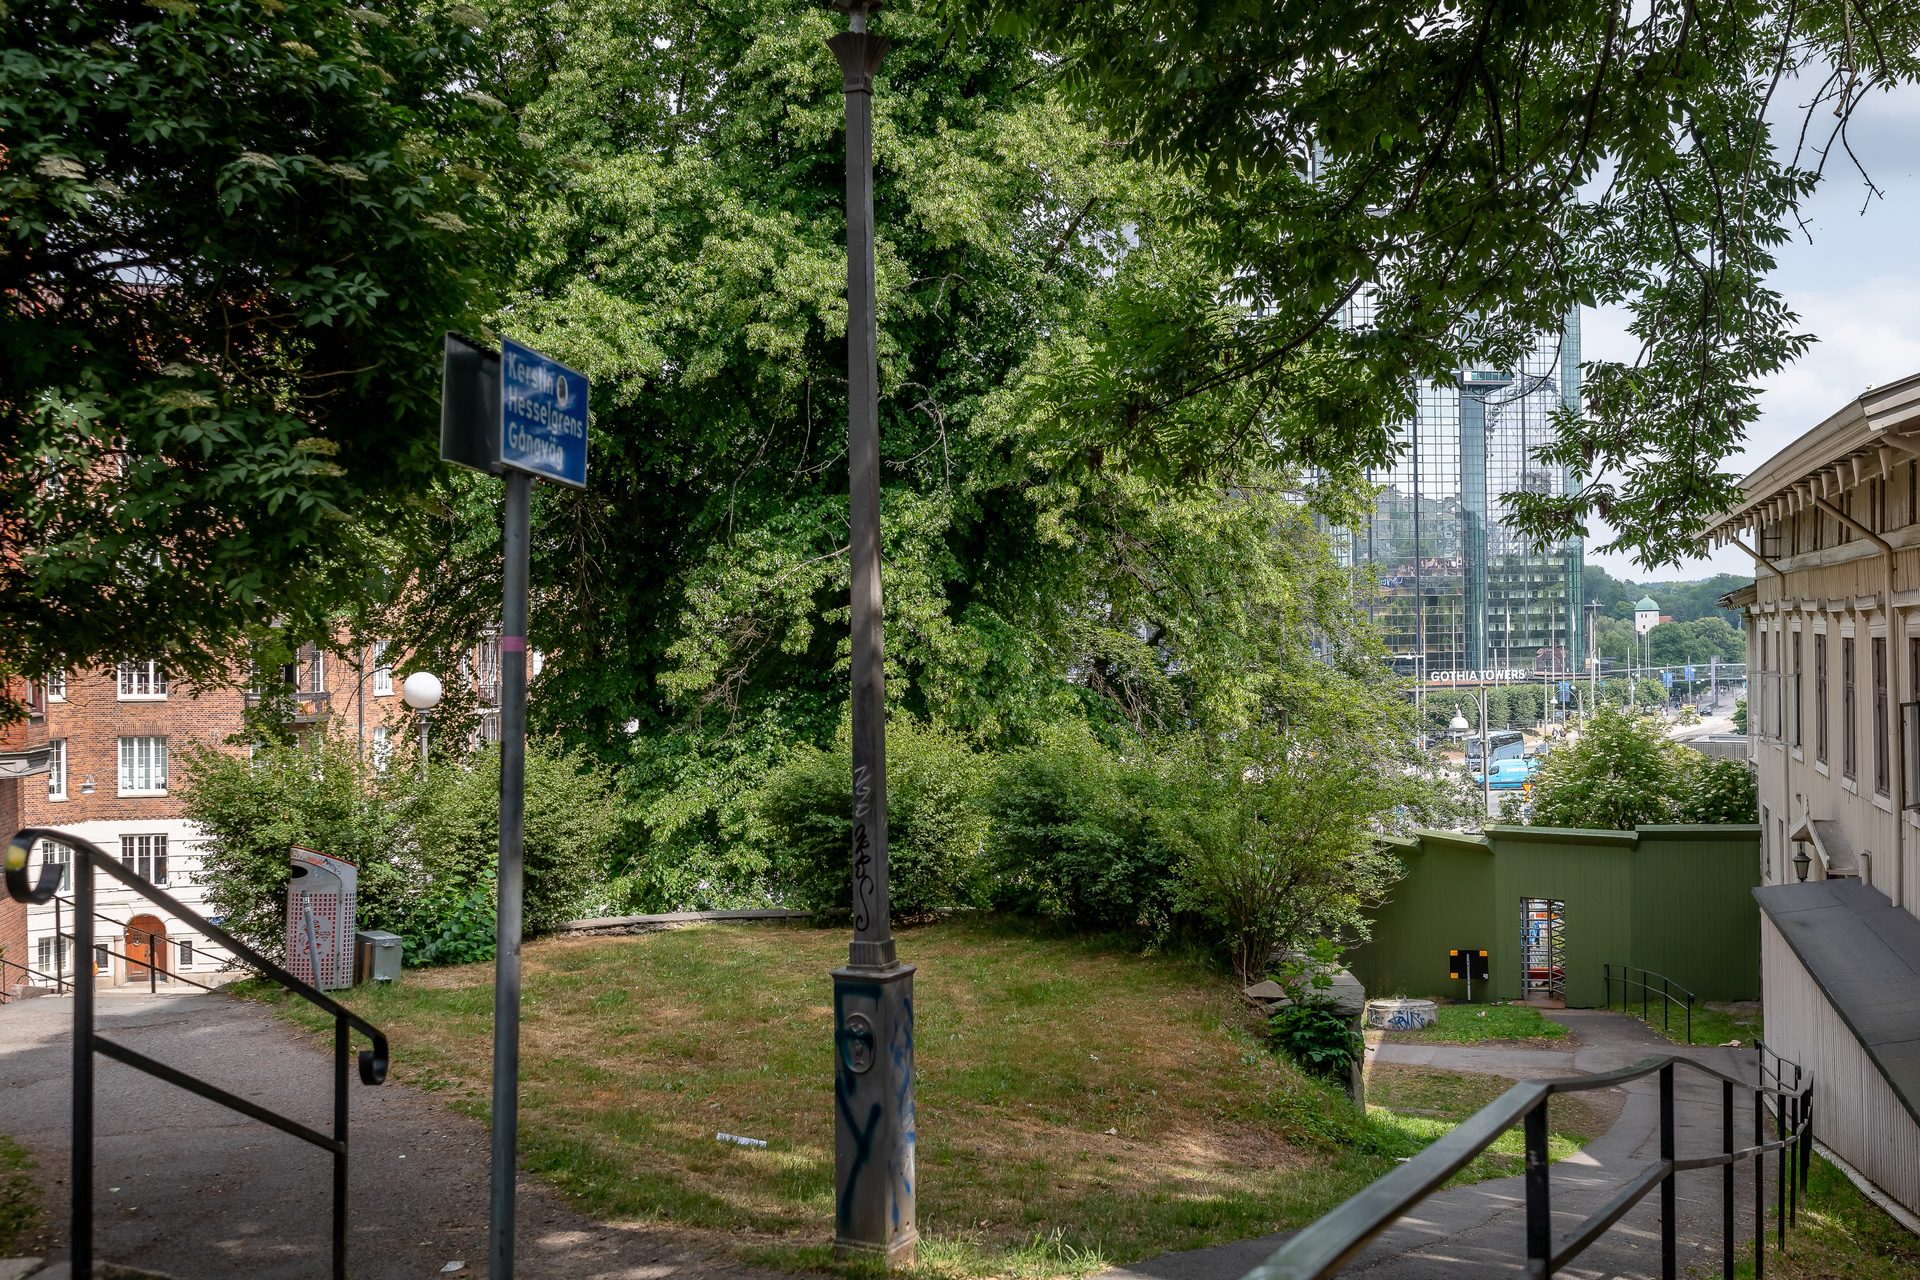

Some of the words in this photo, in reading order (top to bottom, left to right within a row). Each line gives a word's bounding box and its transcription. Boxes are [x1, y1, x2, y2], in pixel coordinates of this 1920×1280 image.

[507, 351, 554, 395] Kerstin
[508, 385, 583, 440] Hesselgrens
[508, 422, 564, 470] Gångväg
[1430, 670, 1478, 682] GOTHIA
[1479, 669, 1526, 681] TOWERS
